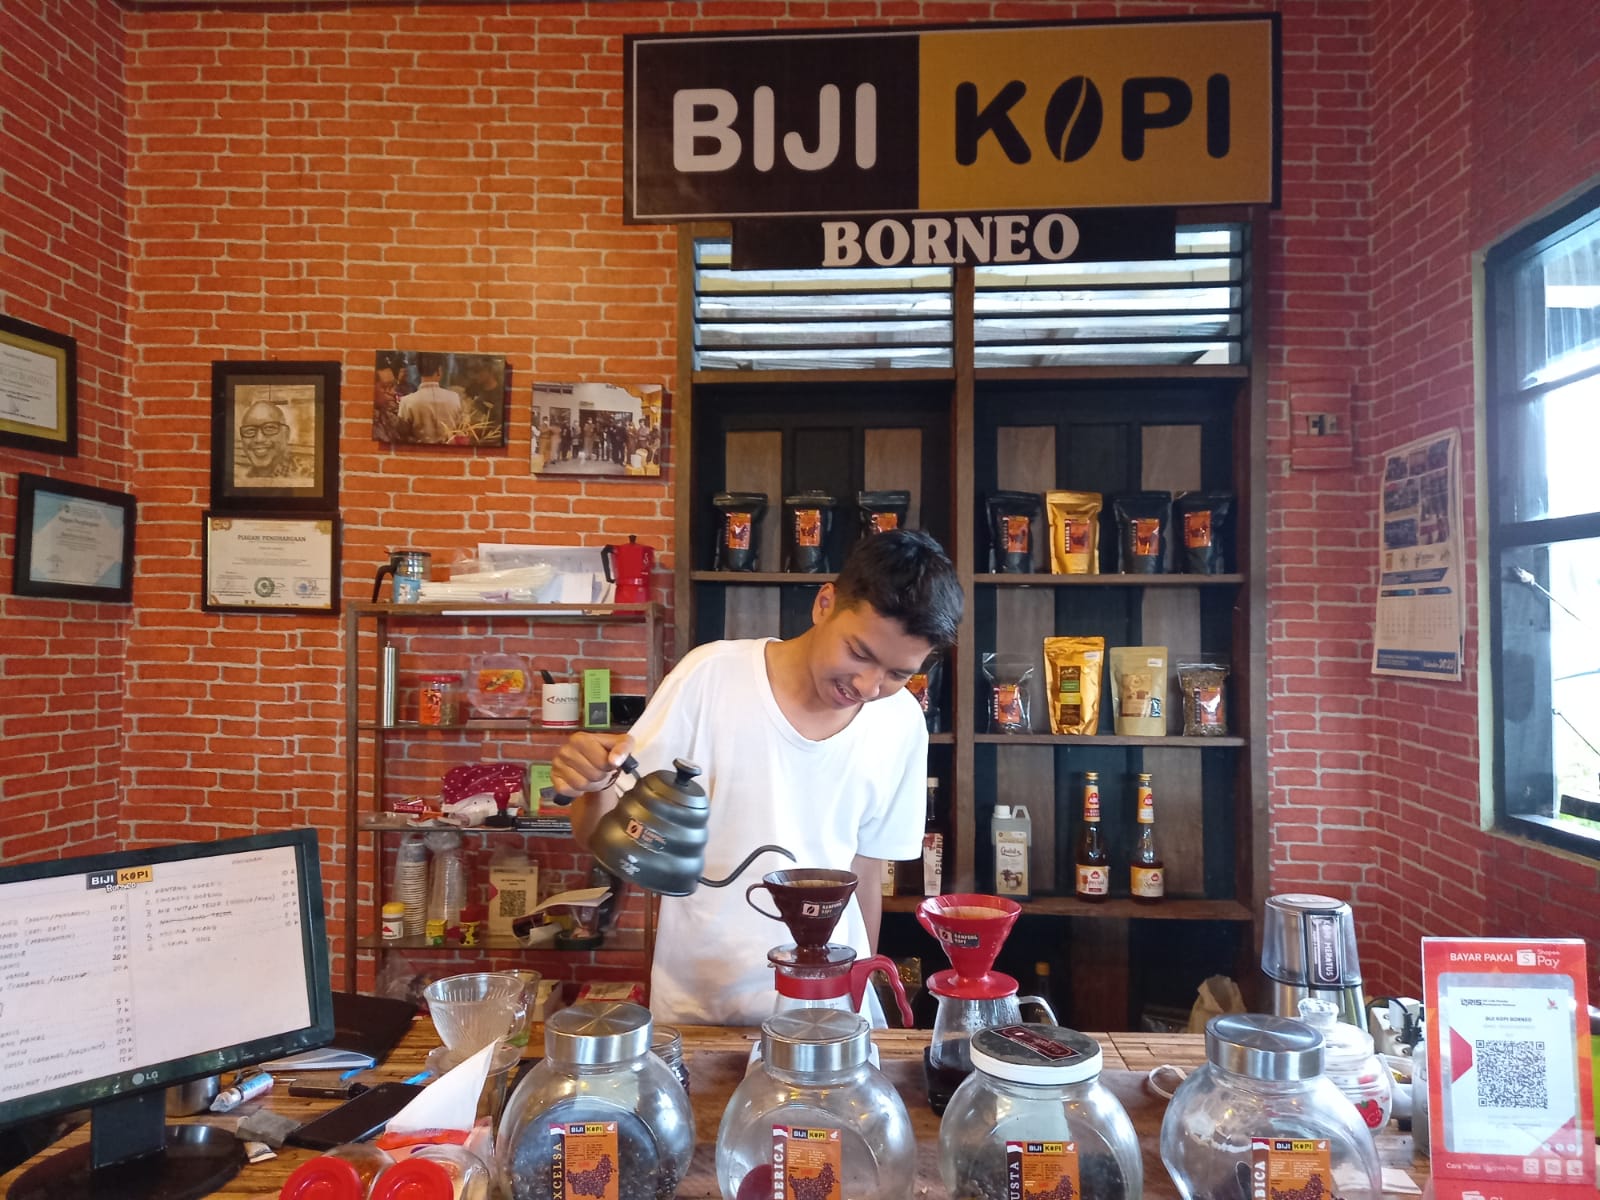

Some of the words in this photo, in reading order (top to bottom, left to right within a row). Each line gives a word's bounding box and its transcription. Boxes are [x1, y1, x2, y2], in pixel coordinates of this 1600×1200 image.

[673, 82, 877, 173] BIJI
[954, 72, 1231, 167] KOPI
[820, 212, 1081, 268] BORNEO
[91, 874, 114, 886] BIJI
[120, 870, 149, 881] KOPI
[1449, 952, 1482, 962] BAYAR
[1484, 953, 1514, 962] PAKAI
[1537, 955, 1560, 969] Pay
[1461, 999, 1482, 1008] QRIS
[145, 1070, 159, 1080] LG
